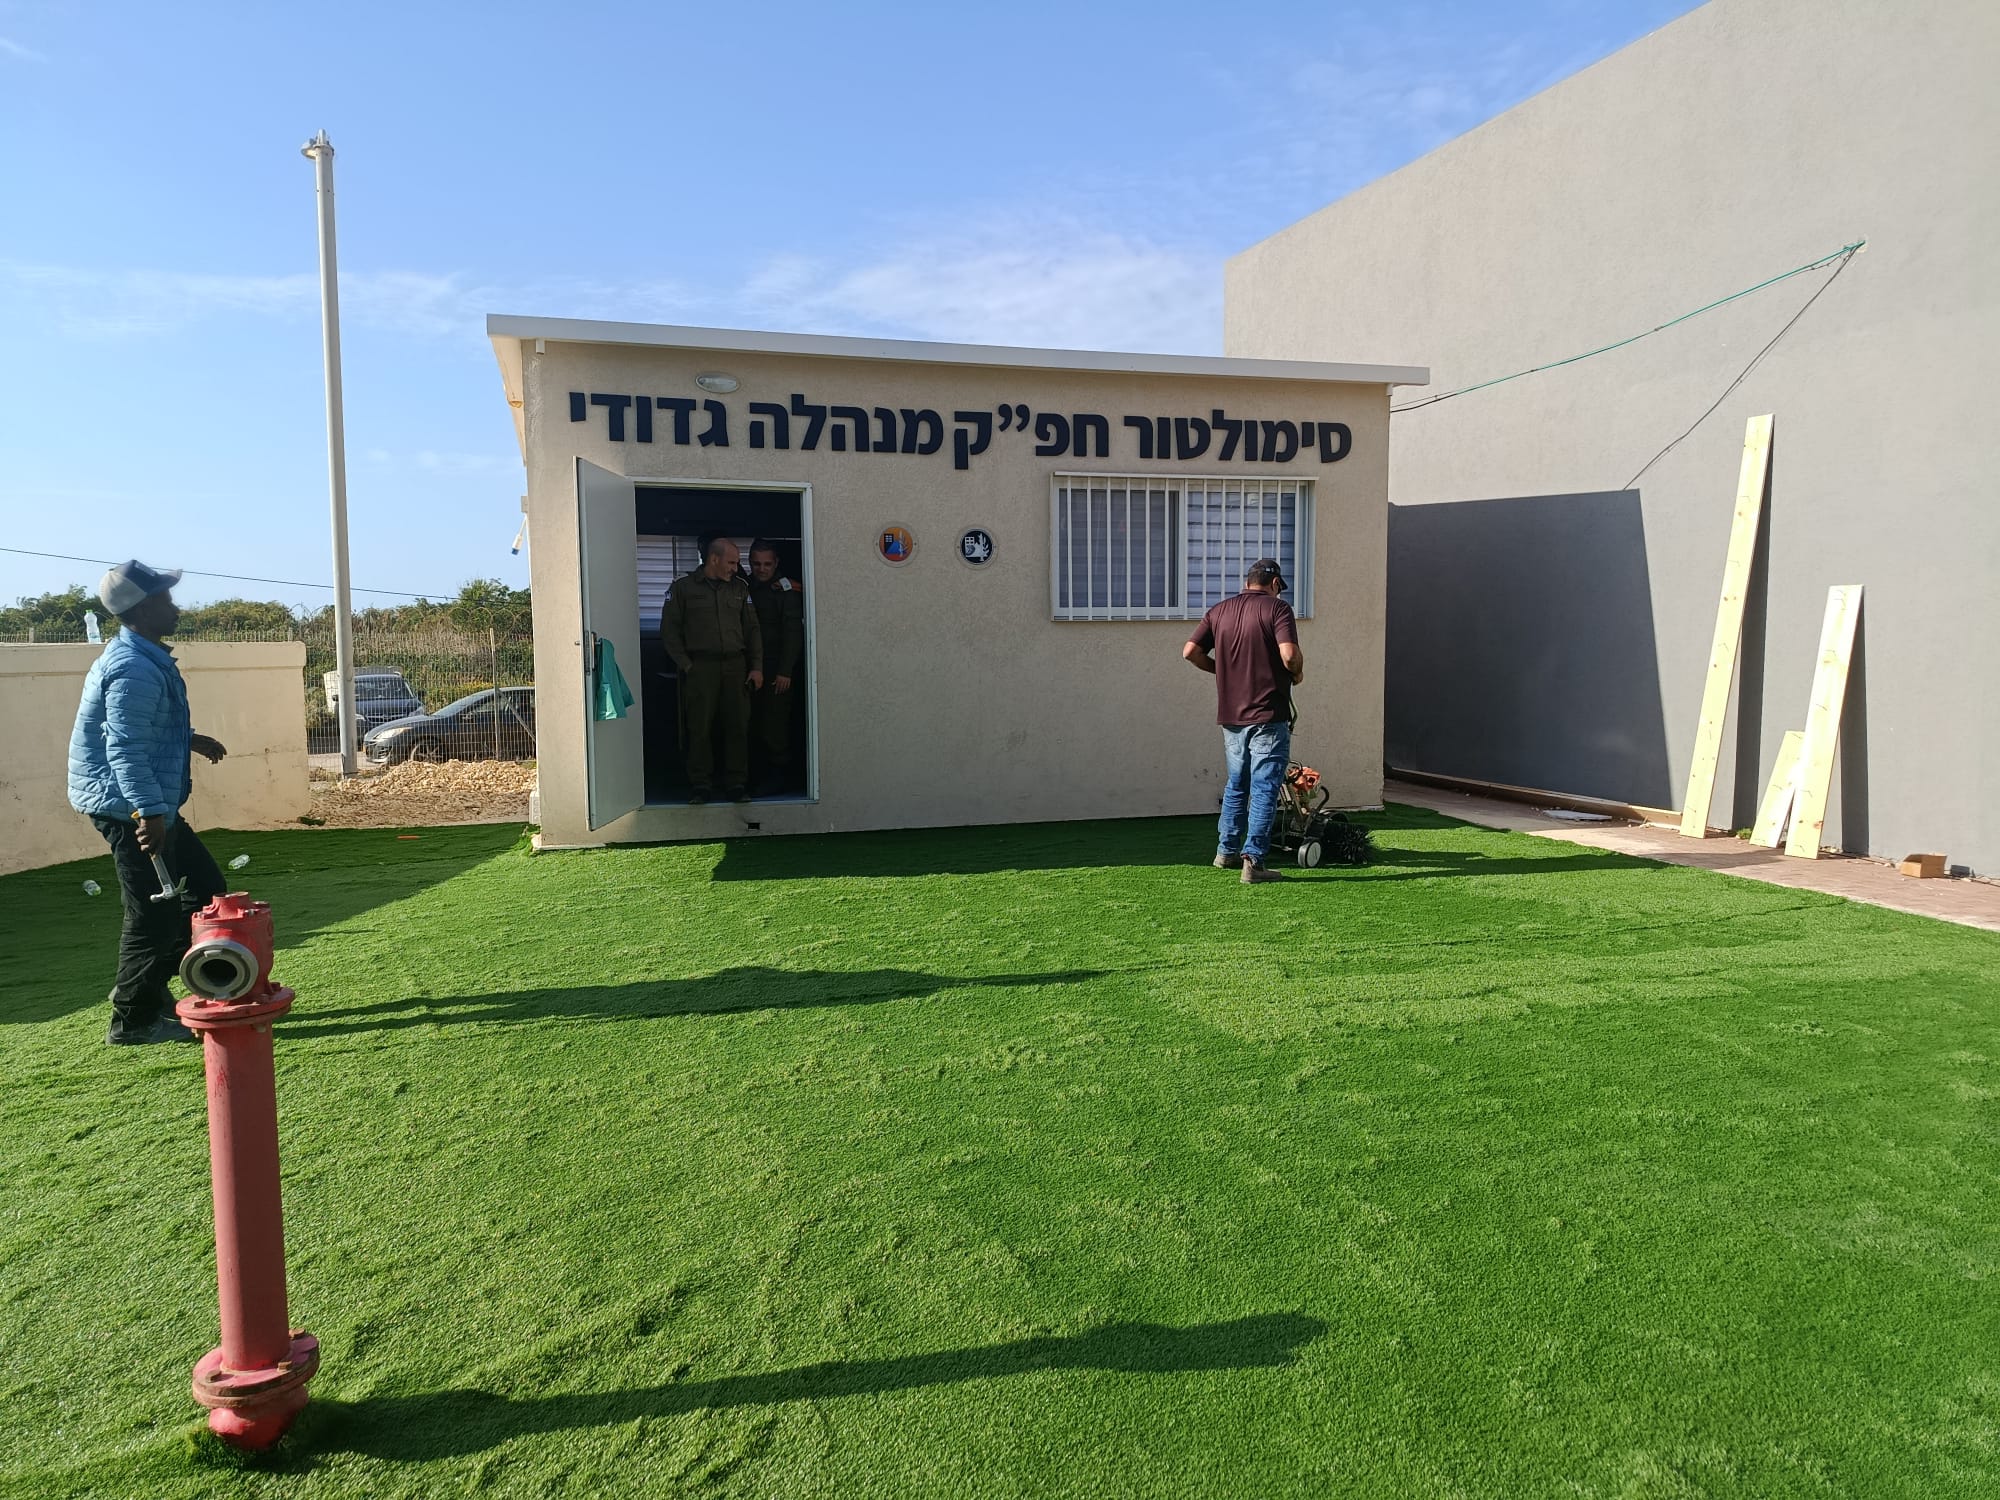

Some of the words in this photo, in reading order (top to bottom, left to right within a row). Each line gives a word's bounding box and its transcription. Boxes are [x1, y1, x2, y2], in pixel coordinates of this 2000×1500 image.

[568, 391, 731, 449] גדודי
[748, 393, 945, 456] מנהלה
[1123, 408, 1353, 464] סימולטור
